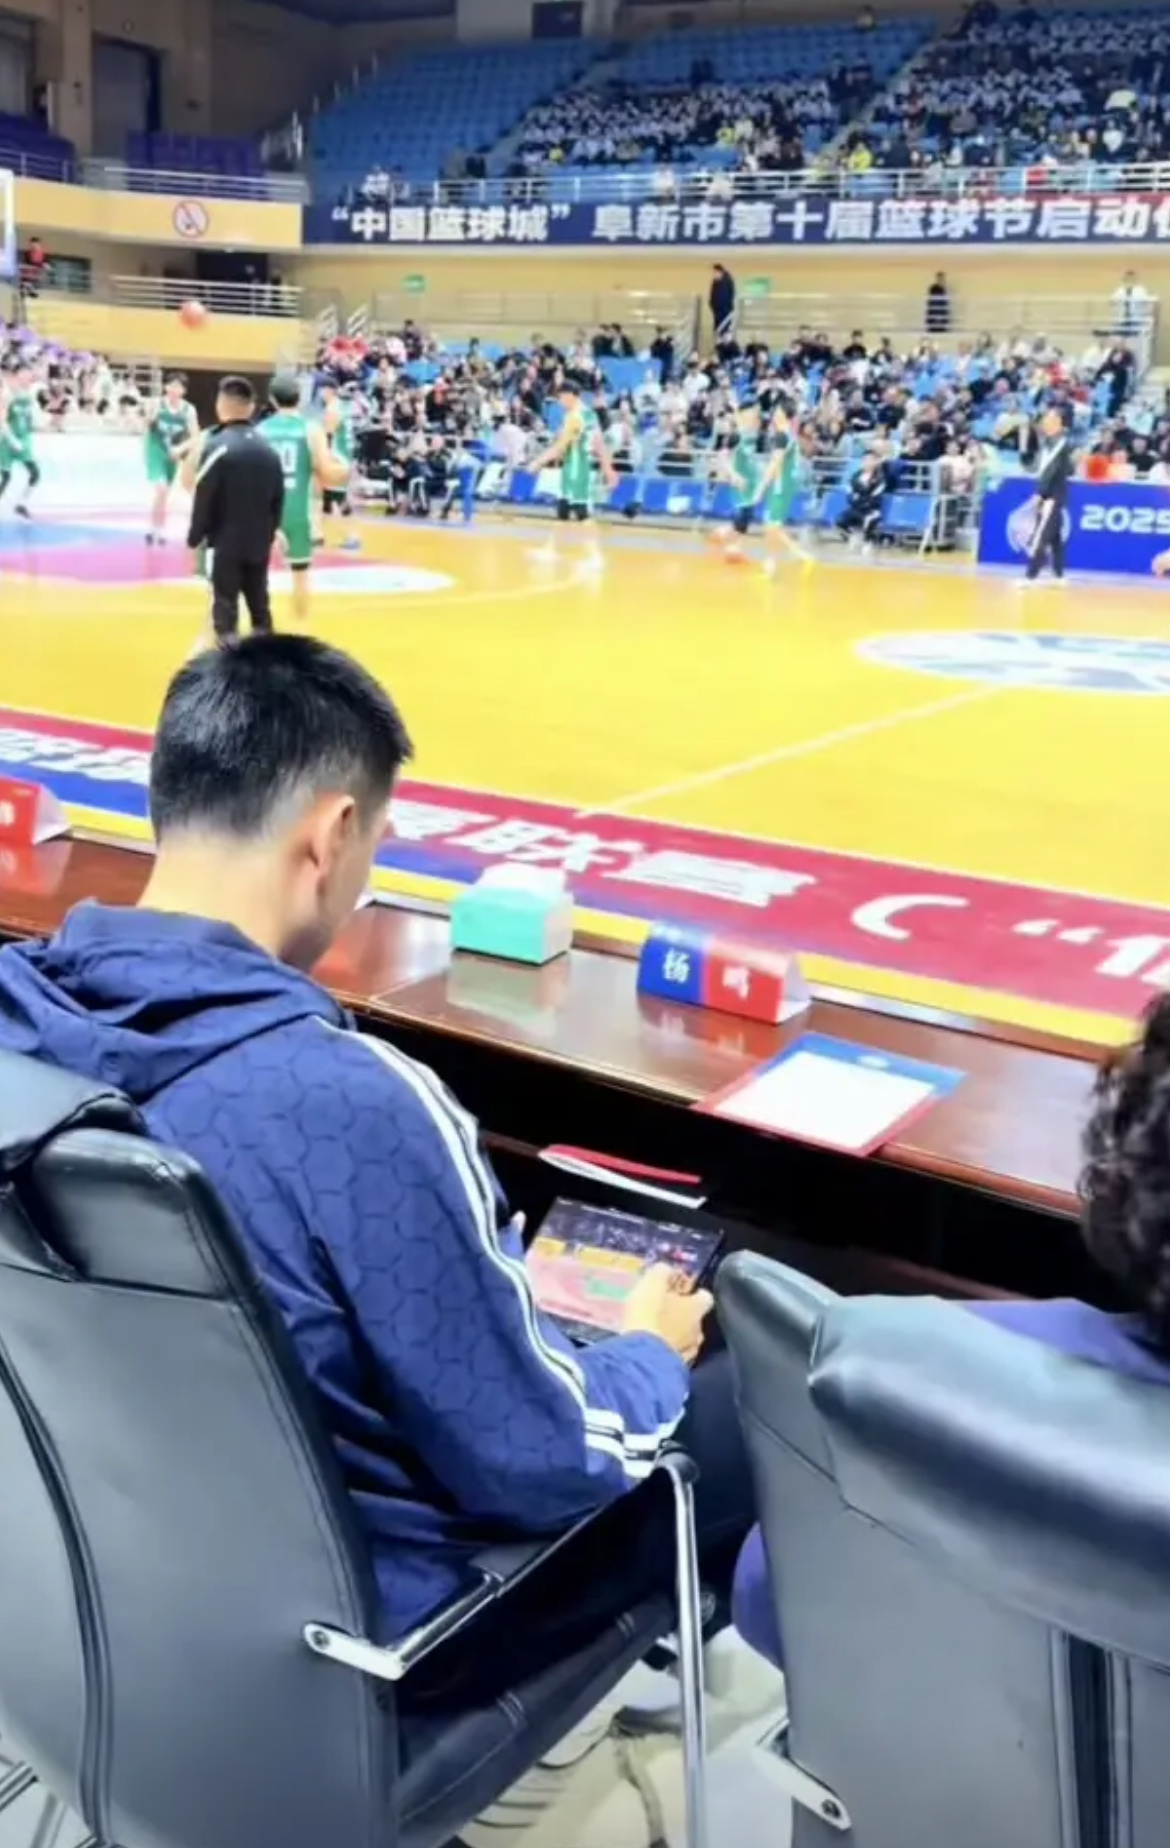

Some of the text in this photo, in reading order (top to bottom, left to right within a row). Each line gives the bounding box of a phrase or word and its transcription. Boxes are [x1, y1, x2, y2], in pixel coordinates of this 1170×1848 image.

[332, 203, 570, 241] “中国篮球城”
